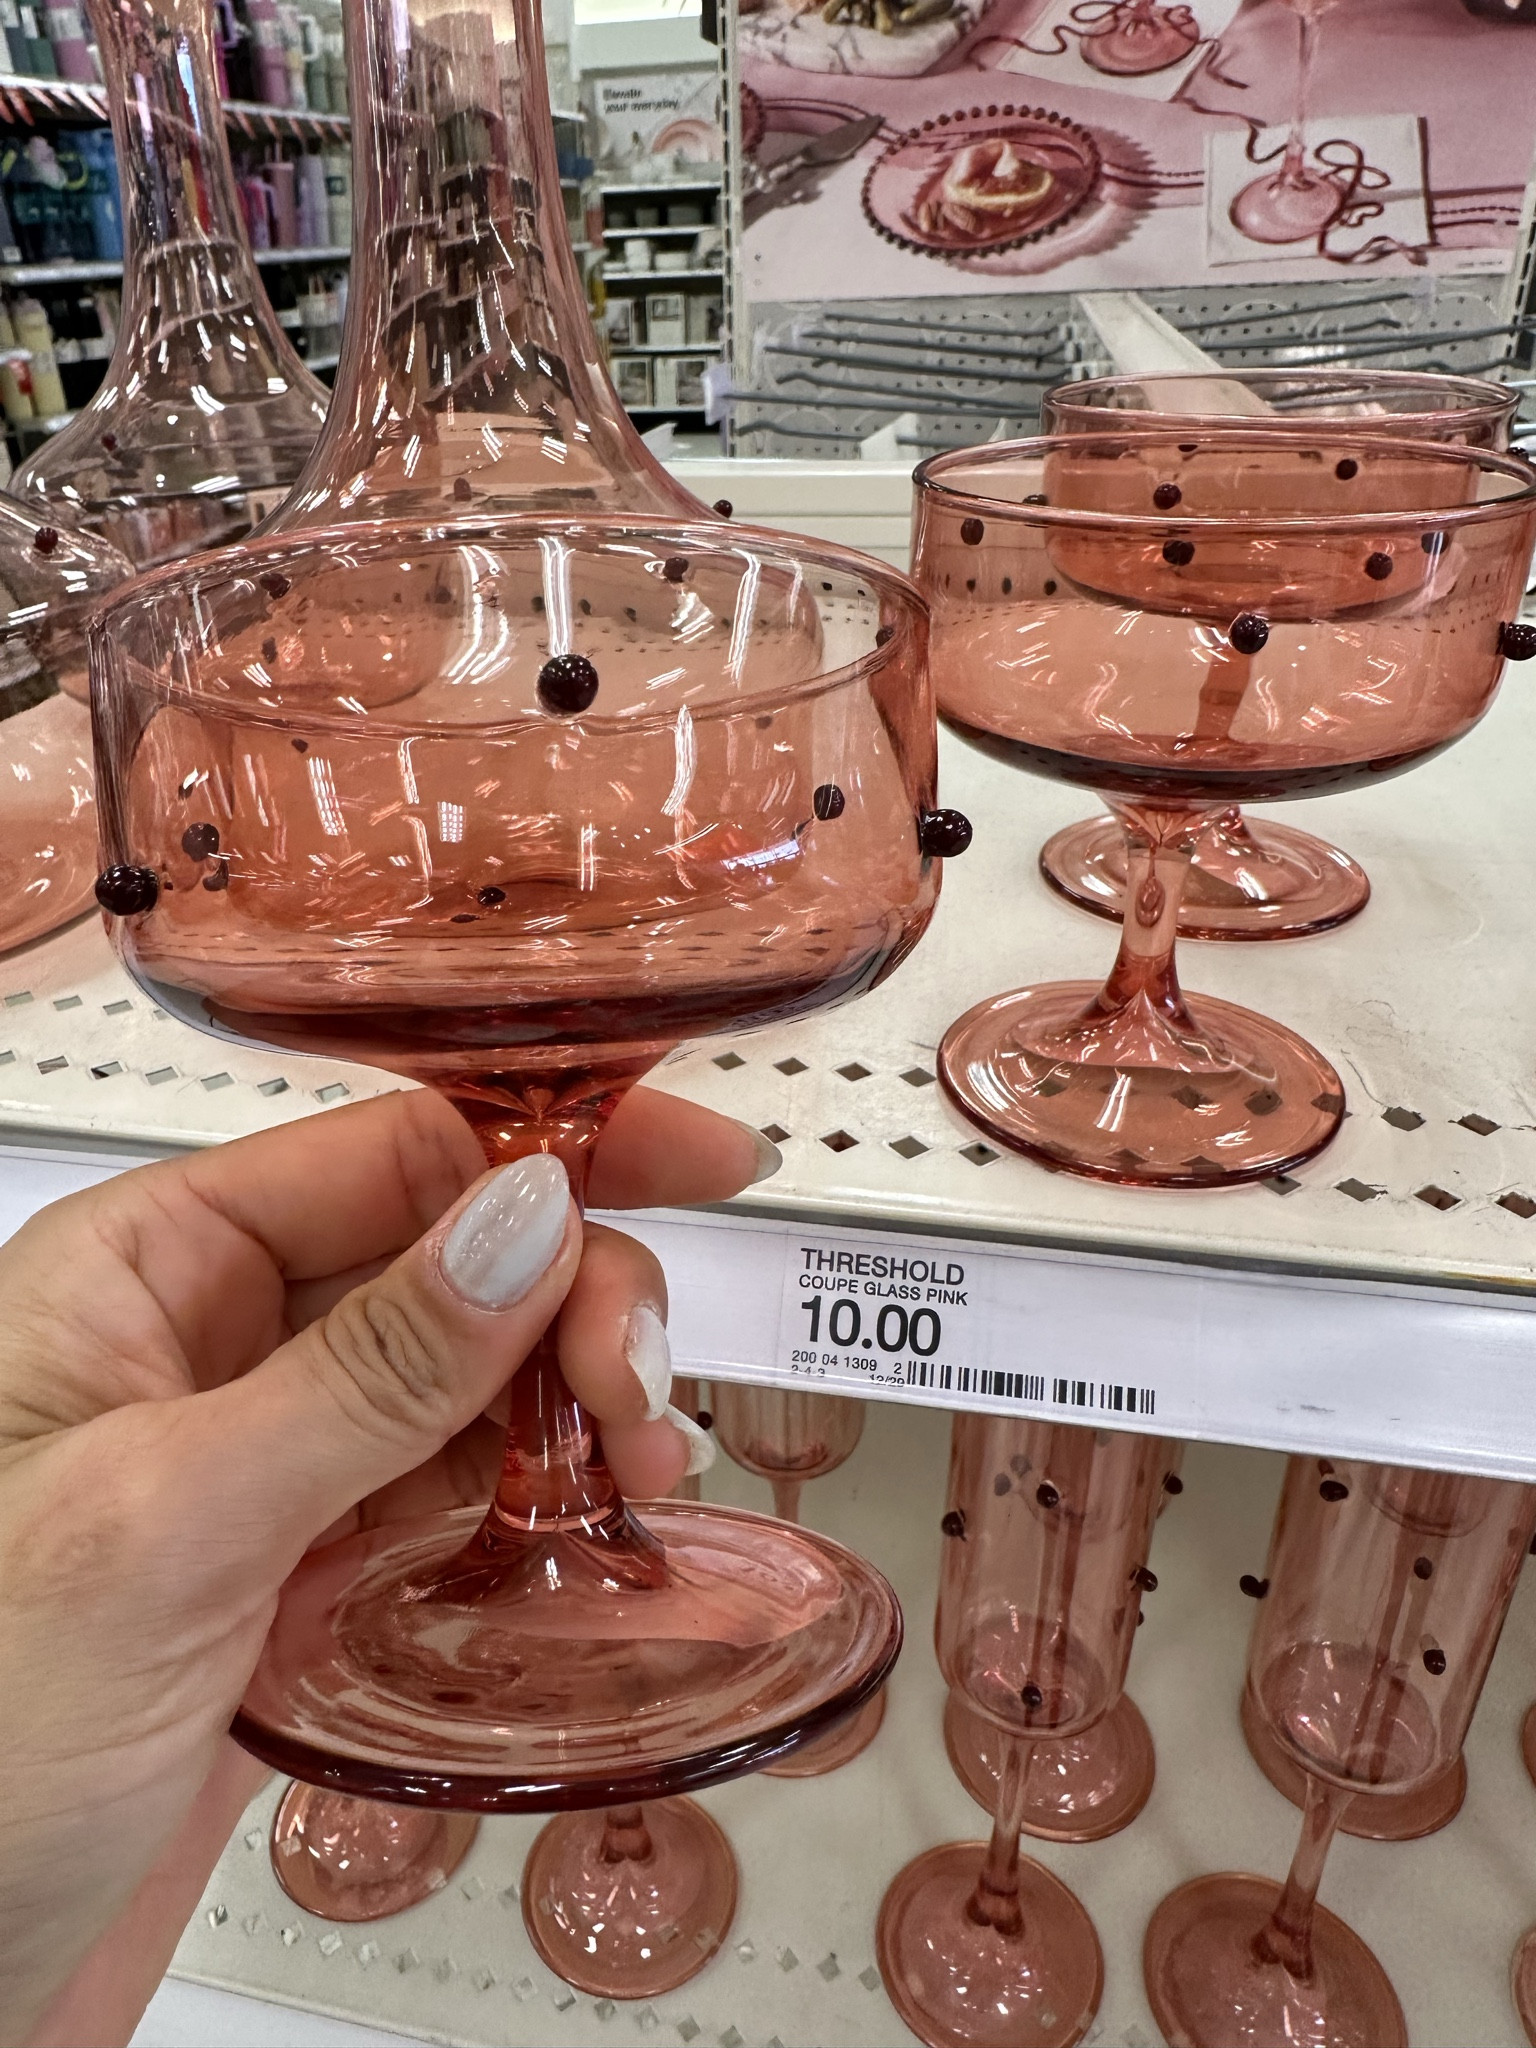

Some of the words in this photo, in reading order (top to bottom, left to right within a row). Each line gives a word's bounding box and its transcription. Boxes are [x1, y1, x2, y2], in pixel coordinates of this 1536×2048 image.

[800, 1248, 965, 1286] THRESHOLD
[799, 1274, 859, 1294] COUPE
[864, 1281, 921, 1301] GLASS
[926, 1288, 968, 1306] PINK
[801, 1295, 942, 1357] 10.00
[791, 1350, 817, 1364] 200
[822, 1354, 839, 1366] 04
[844, 1356, 878, 1372] 1309
[893, 1362, 902, 1375] 2
